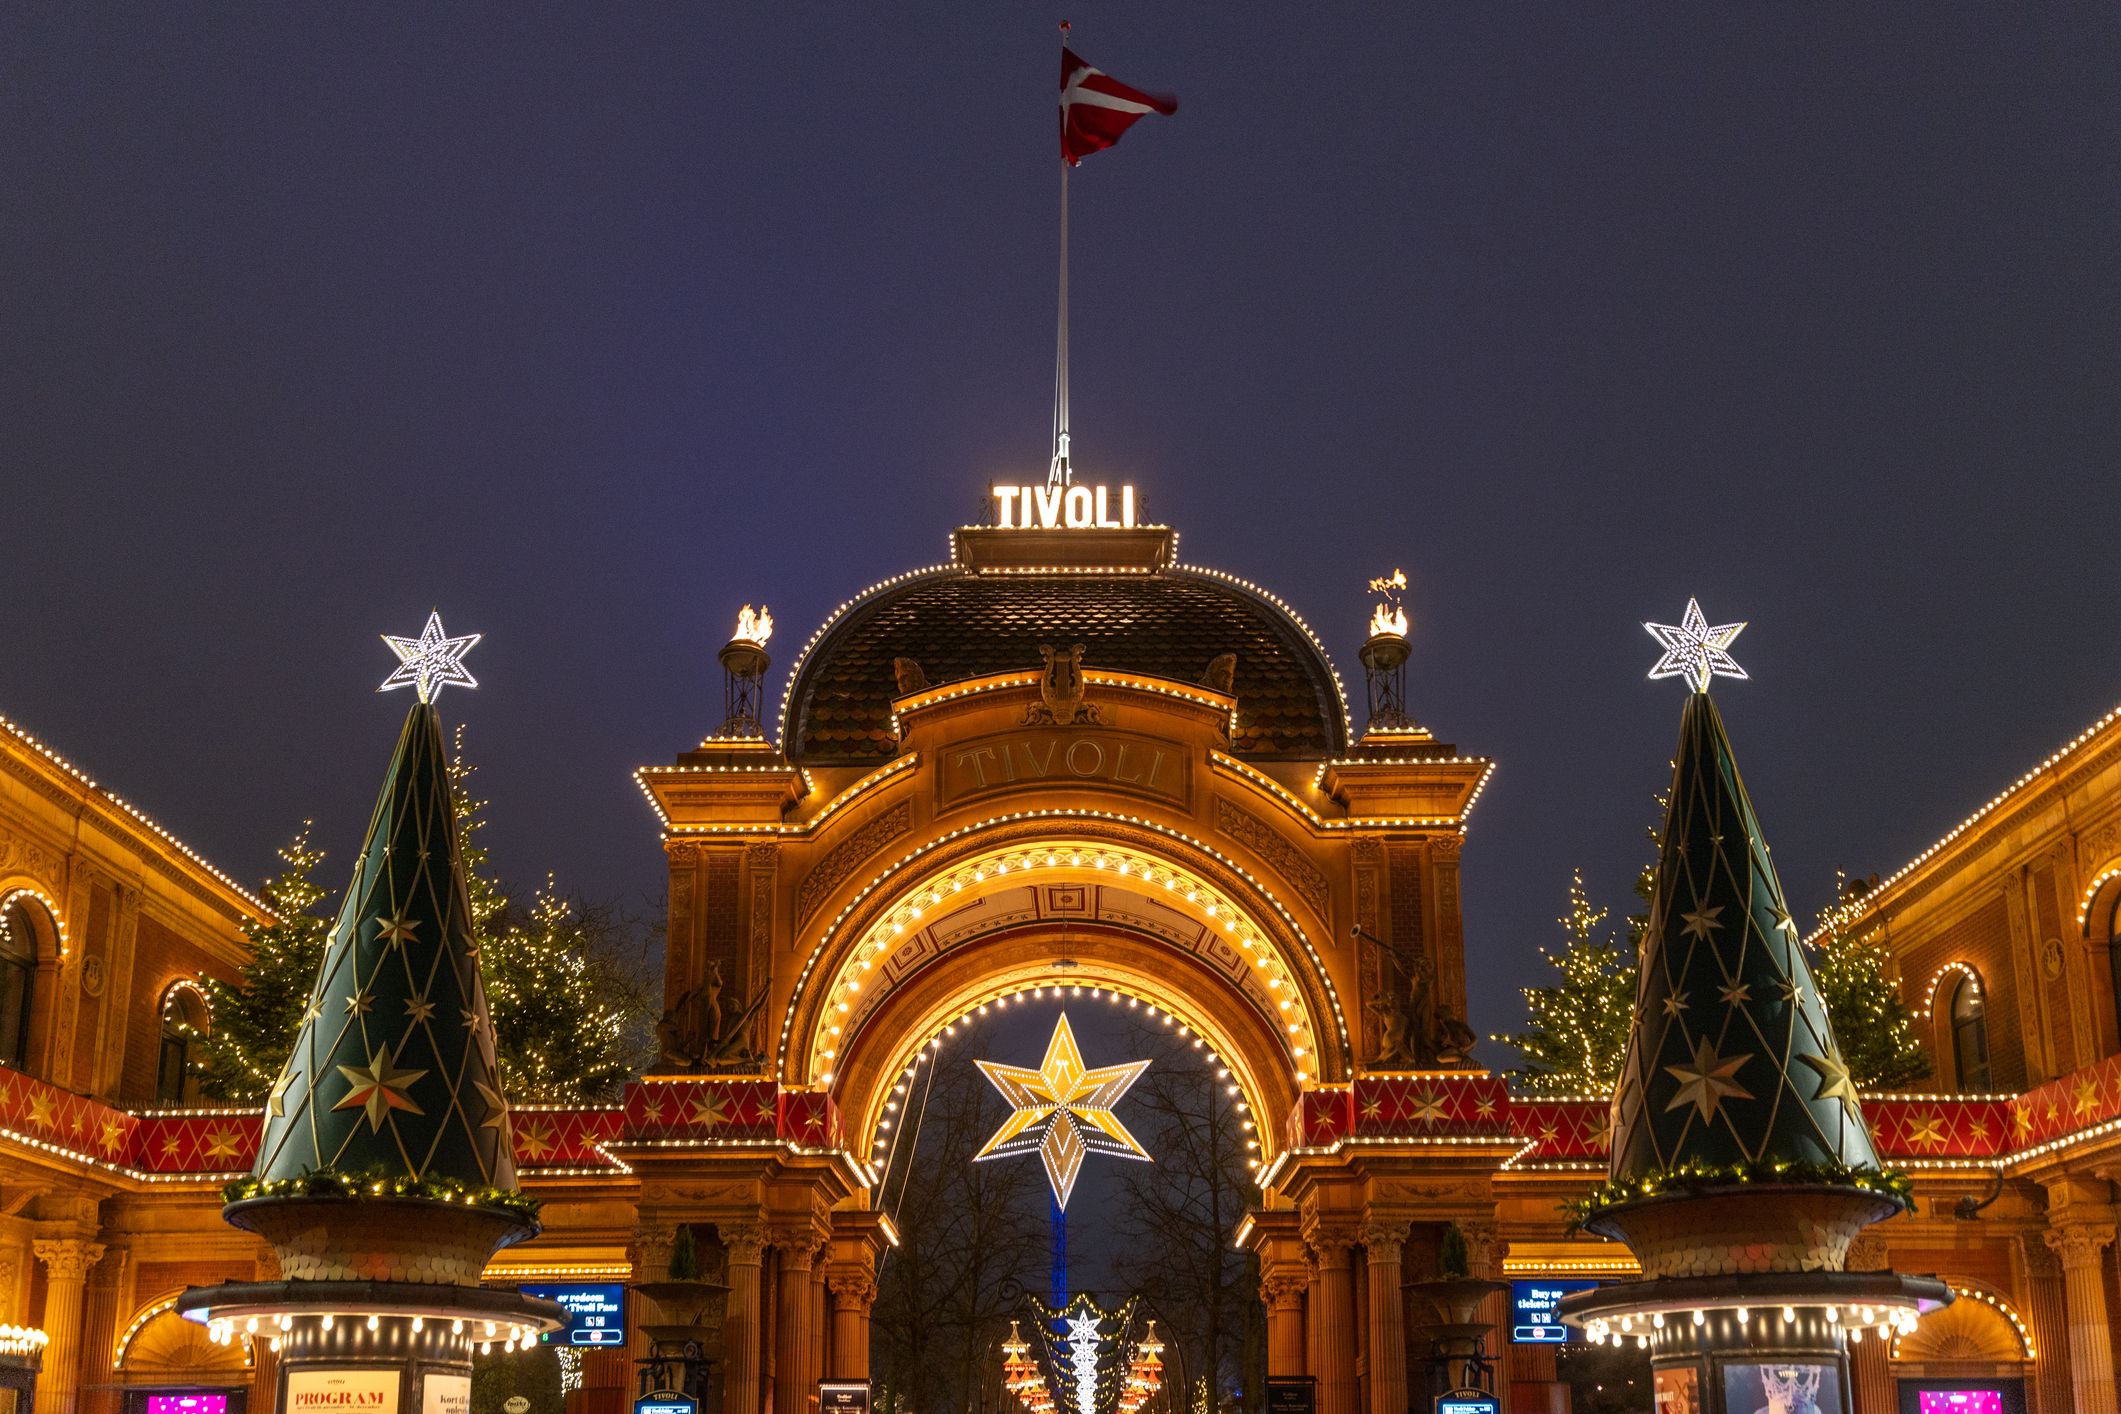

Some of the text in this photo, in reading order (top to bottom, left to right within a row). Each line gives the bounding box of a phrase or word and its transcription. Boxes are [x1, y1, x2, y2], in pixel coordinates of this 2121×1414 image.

[993, 486, 1135, 528] TIVOLI
[957, 739, 1166, 788] TIVOLI
[569, 1292, 605, 1302] redeem
[1531, 1289, 1550, 1300] Buy
[569, 1302, 596, 1312] Tivoli
[597, 1303, 618, 1312] Pass
[1518, 1299, 1549, 1309] tickets
[296, 1392, 384, 1405] PROGRAM
[440, 1394, 458, 1404] Kort
